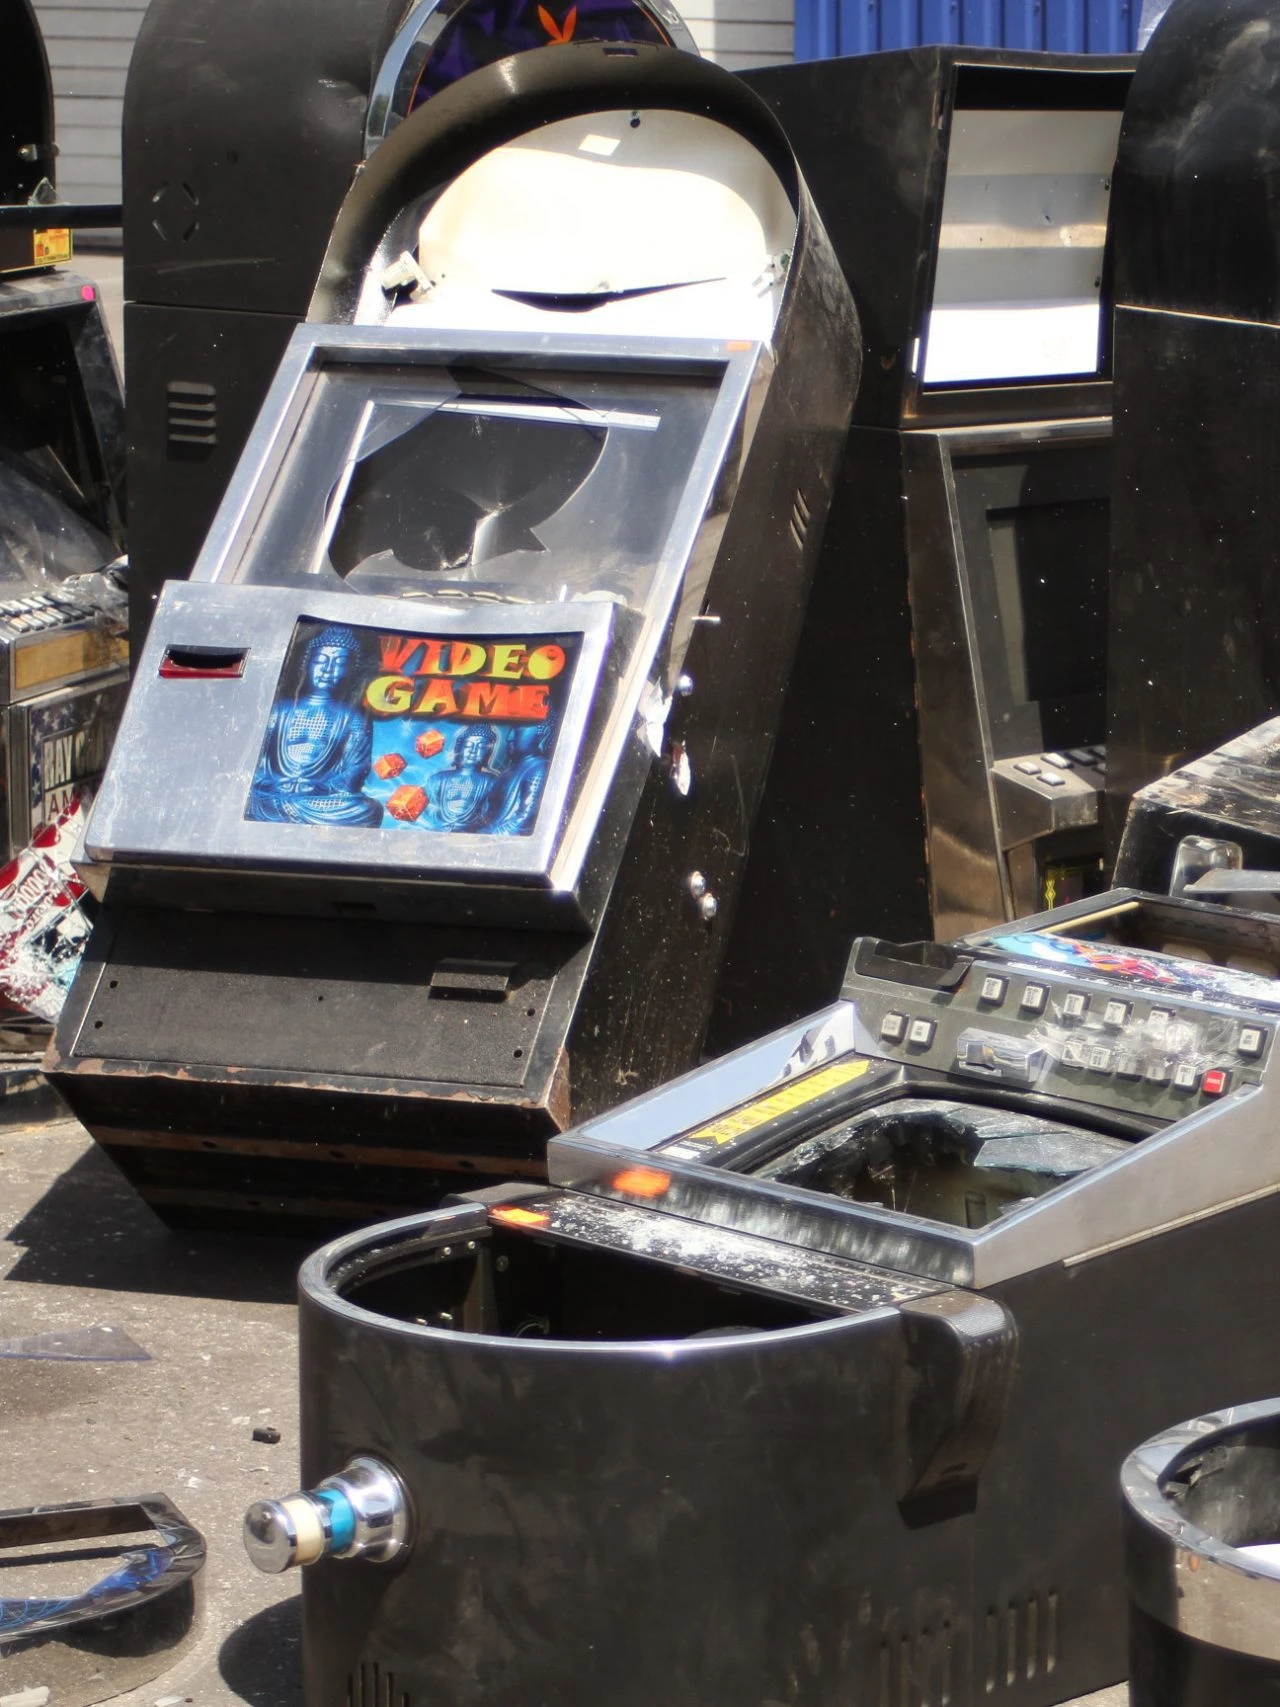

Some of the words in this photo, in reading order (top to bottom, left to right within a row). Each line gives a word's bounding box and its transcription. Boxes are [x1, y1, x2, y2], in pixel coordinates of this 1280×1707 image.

[378, 635, 566, 680] VIDEO
[363, 675, 550, 720] GAME
[44, 735, 73, 791] RAY
